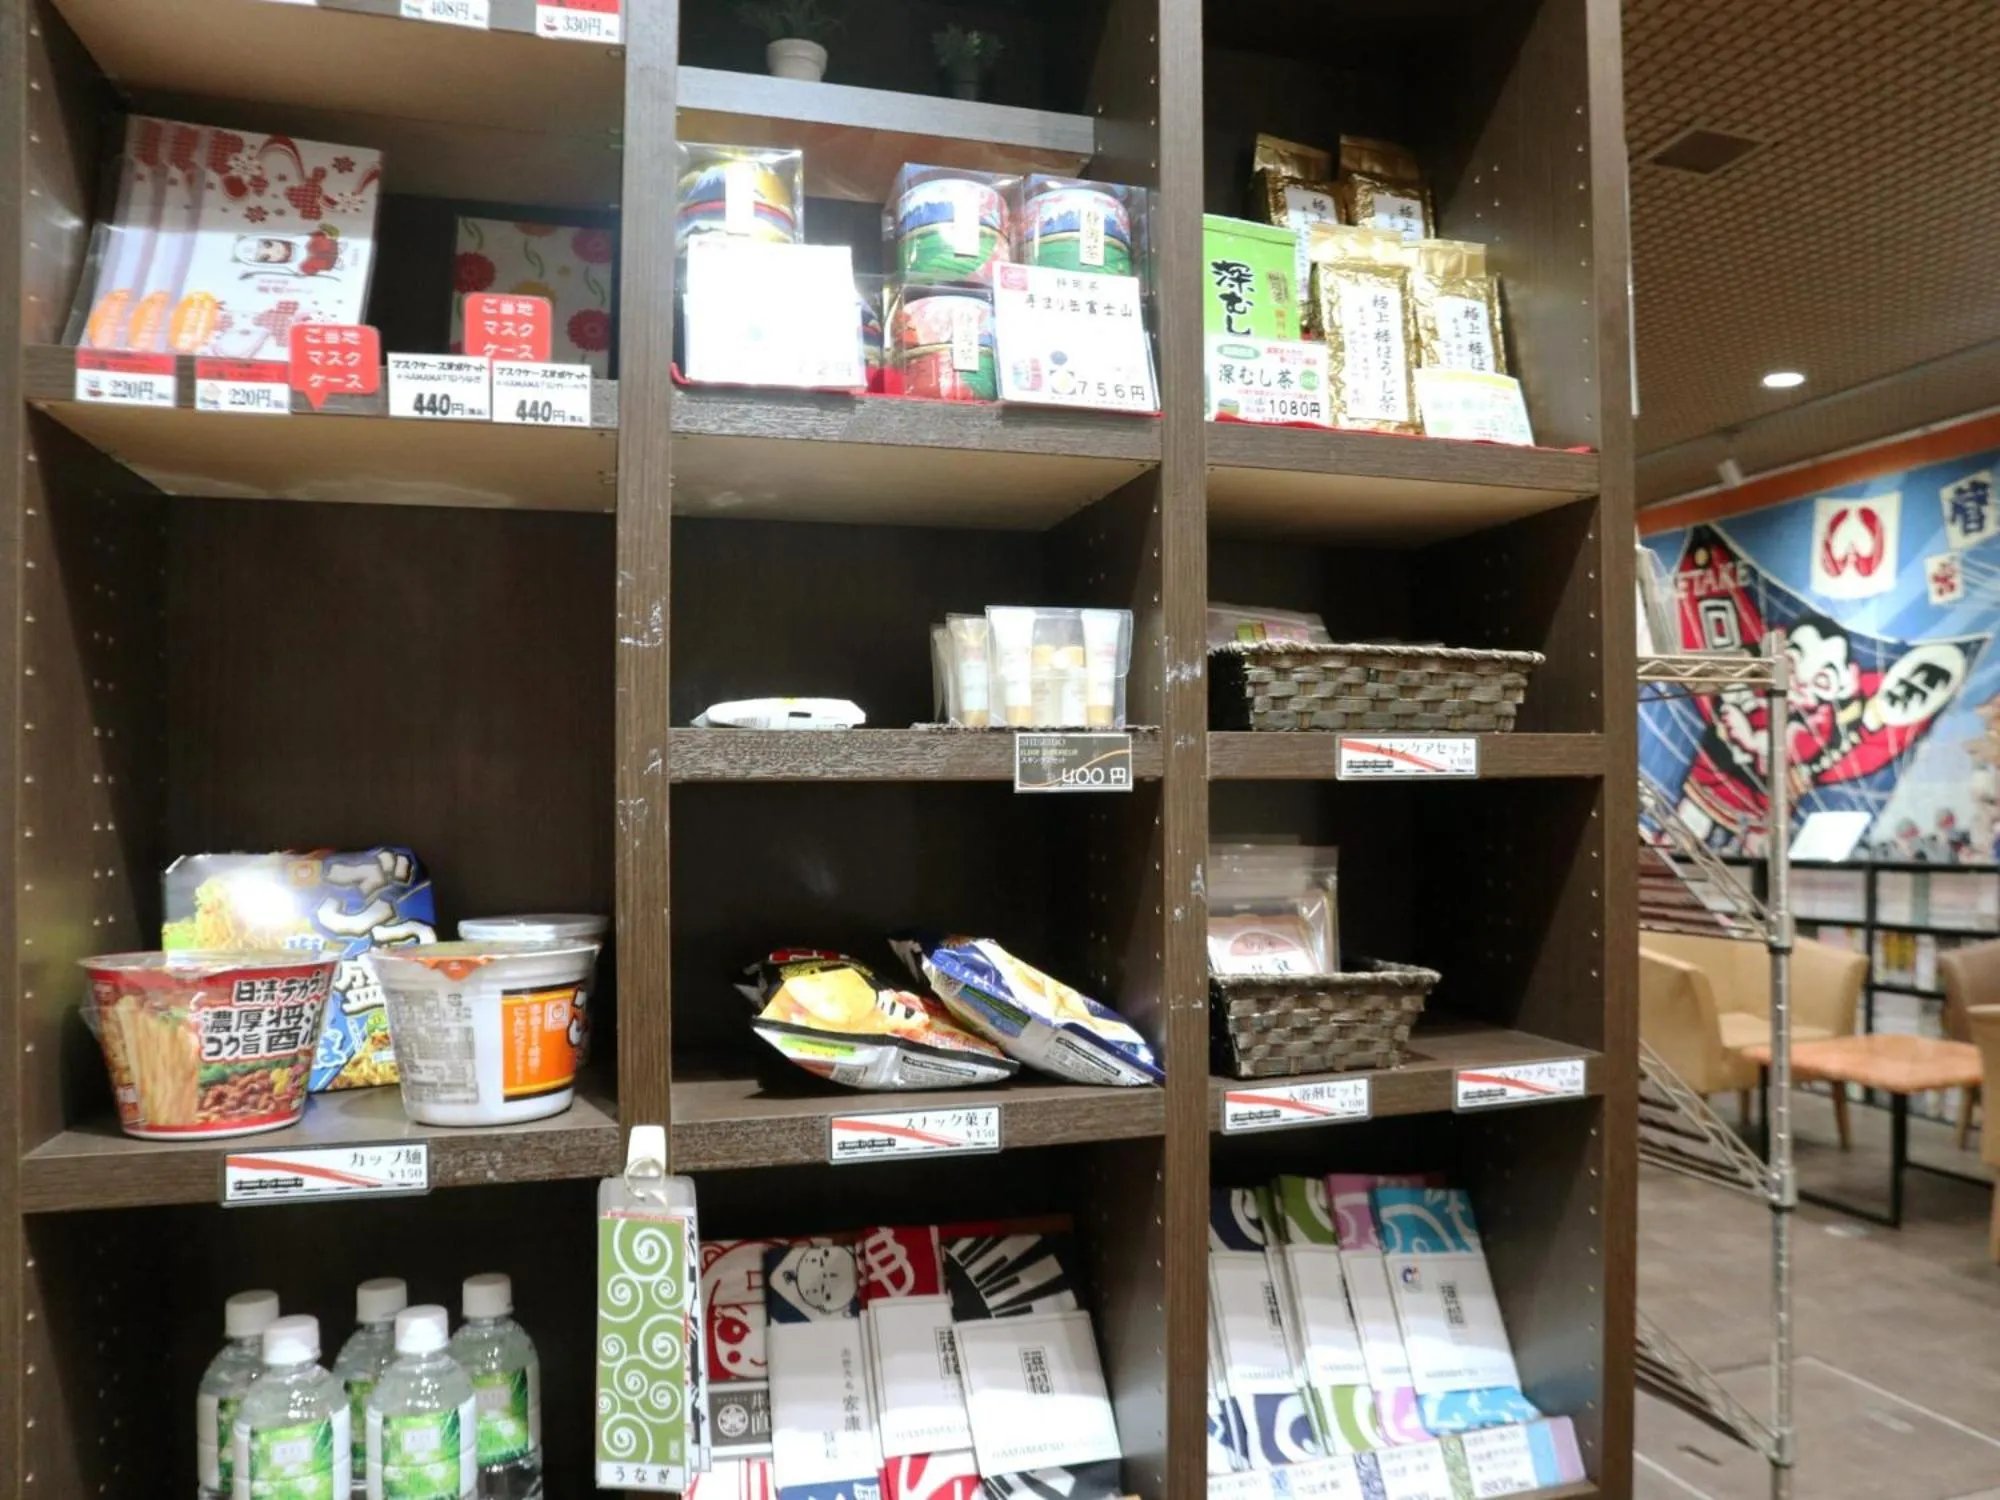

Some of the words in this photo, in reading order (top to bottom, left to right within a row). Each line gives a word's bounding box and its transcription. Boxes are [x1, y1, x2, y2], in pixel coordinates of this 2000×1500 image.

[484, 320, 534, 337] マスク
[307, 350, 361, 366] マスク
[484, 343, 534, 360] ケース
[309, 372, 364, 390] ケース
[1219, 363, 1295, 390] 深むし茶
[1077, 380, 1146, 401] 756円
[413, 393, 465, 416] 440円
[516, 400, 566, 423] 440円
[1269, 399, 1322, 418] 1080円
[904, 1110, 993, 1132] スナック菓子
[615, 1465, 669, 1484] うなぎ
